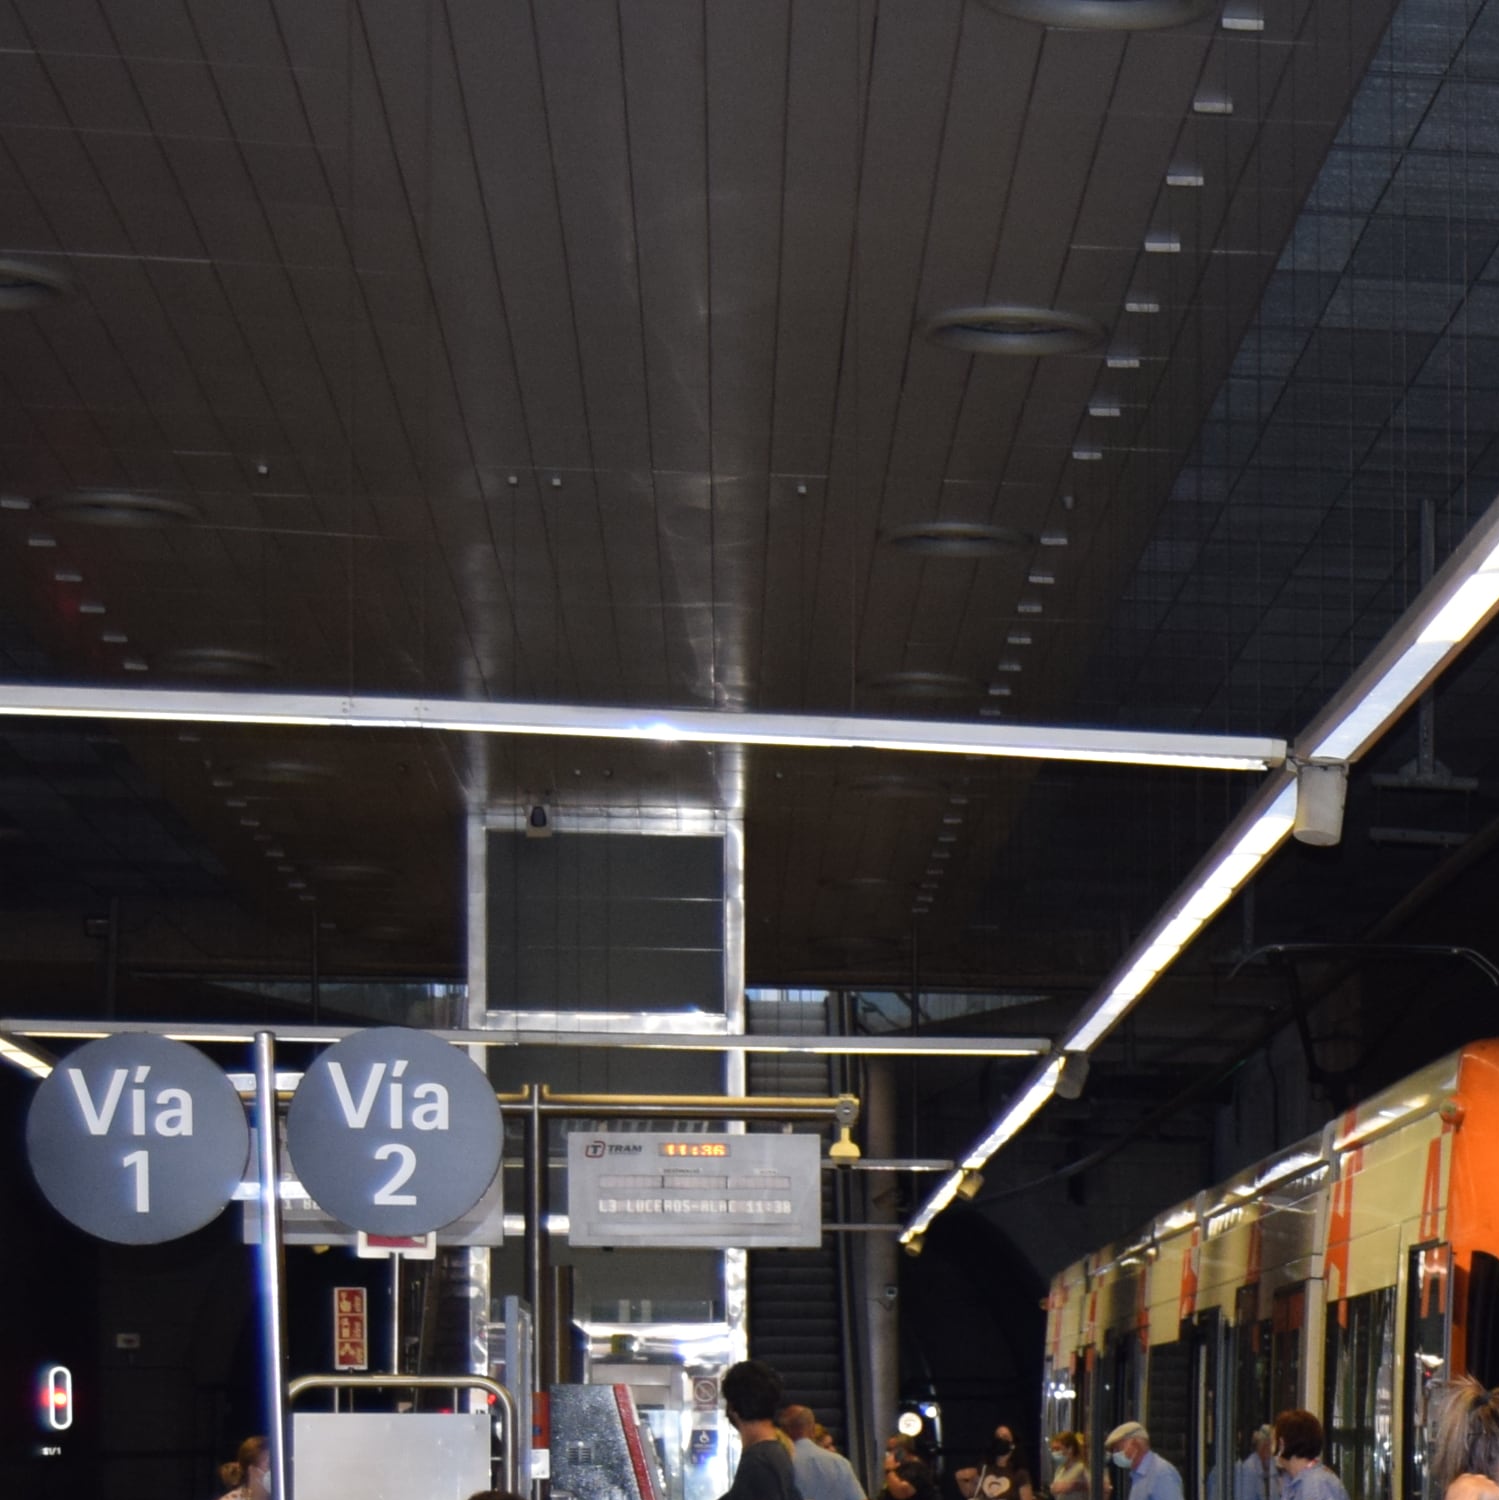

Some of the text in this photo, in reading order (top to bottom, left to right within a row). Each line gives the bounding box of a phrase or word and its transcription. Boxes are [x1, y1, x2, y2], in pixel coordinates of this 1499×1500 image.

[66, 1065, 193, 1137] Vía
[327, 1060, 450, 1131] Vía
[373, 1143, 418, 1206] 2
[608, 1144, 643, 1154] TRAM
[664, 1143, 727, 1157] 11:36
[122, 1150, 150, 1213] 1
[598, 1199, 617, 1214] L3
